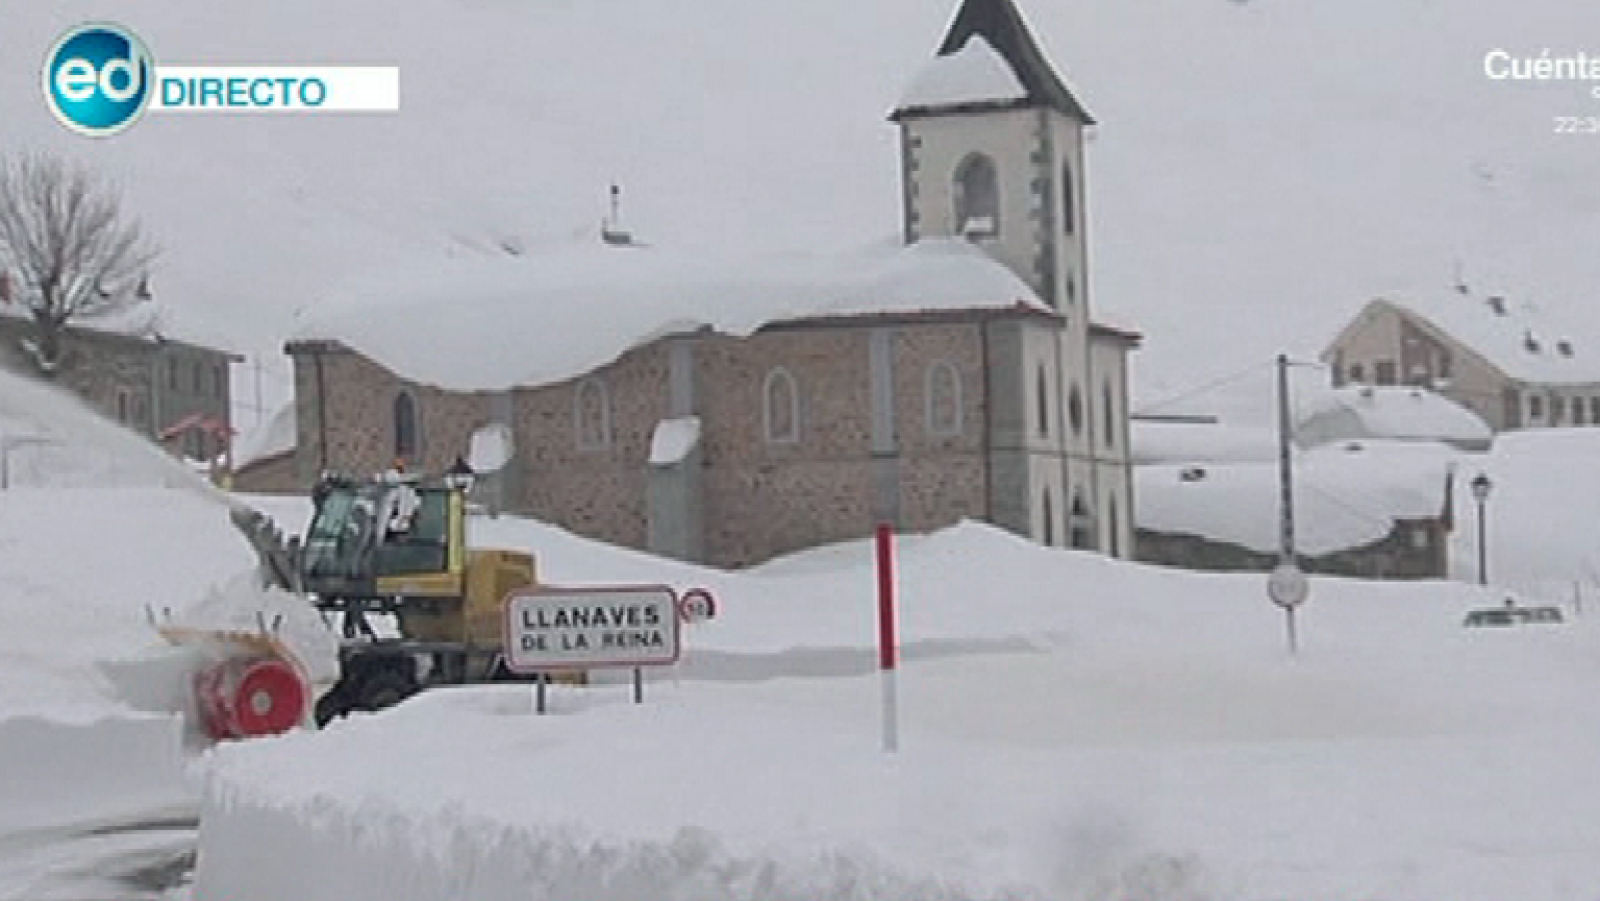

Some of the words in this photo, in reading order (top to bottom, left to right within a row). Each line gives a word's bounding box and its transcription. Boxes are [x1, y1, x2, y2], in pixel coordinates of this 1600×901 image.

[521, 605, 660, 628] LLANAVES
[521, 633, 549, 651] DE
[562, 632, 588, 650] LA
[601, 630, 663, 649] REINA
